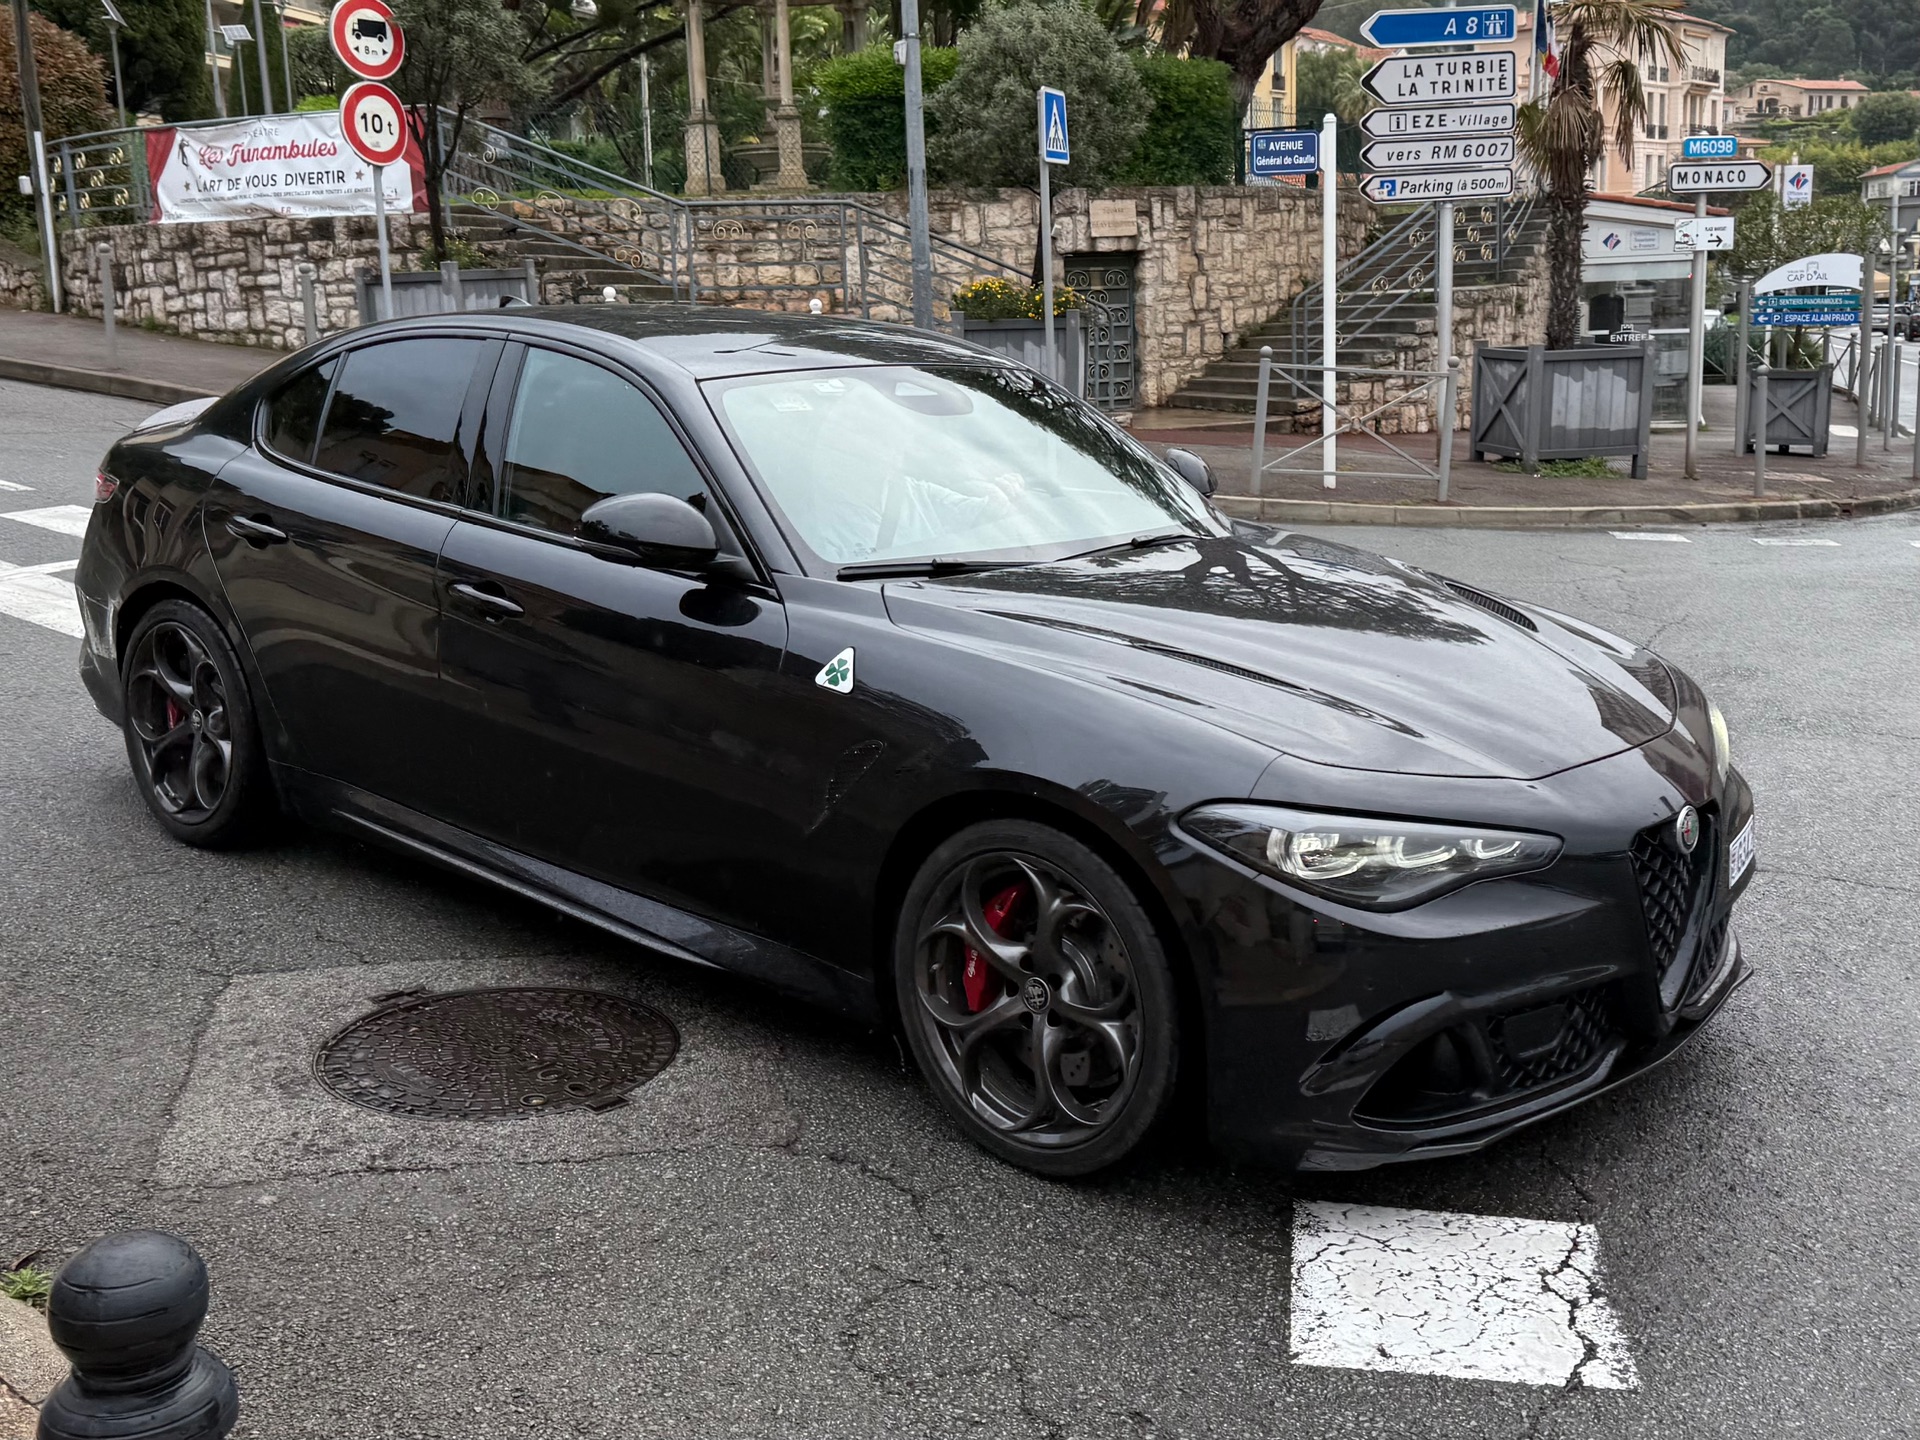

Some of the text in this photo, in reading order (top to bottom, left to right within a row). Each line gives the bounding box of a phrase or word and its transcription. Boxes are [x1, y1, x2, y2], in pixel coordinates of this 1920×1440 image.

[1443, 16, 1479, 35] A 8
[1403, 59, 1508, 78] LA TURBIE
[1398, 74, 1508, 97] LA TRINITÉ
[360, 112, 394, 136] 10 t
[199, 138, 338, 170] Les Funambules
[1268, 140, 1304, 151] AVENUE
[1387, 142, 1509, 161] vers RM 6007
[1689, 139, 1733, 154] M6098
[1256, 154, 1315, 166] Général de Gaulle
[197, 170, 346, 193] L'ART DE VOUS DIVERTIR
[1677, 169, 1746, 185] MONACO
[1399, 179, 1454, 195] Parking
[1457, 178, 1467, 192] (à
[1787, 273, 1805, 282] CAP
[1784, 314, 1811, 323] ESPACE
[1811, 314, 1831, 322] ALAIN
[1831, 313, 1855, 322] PRADO
